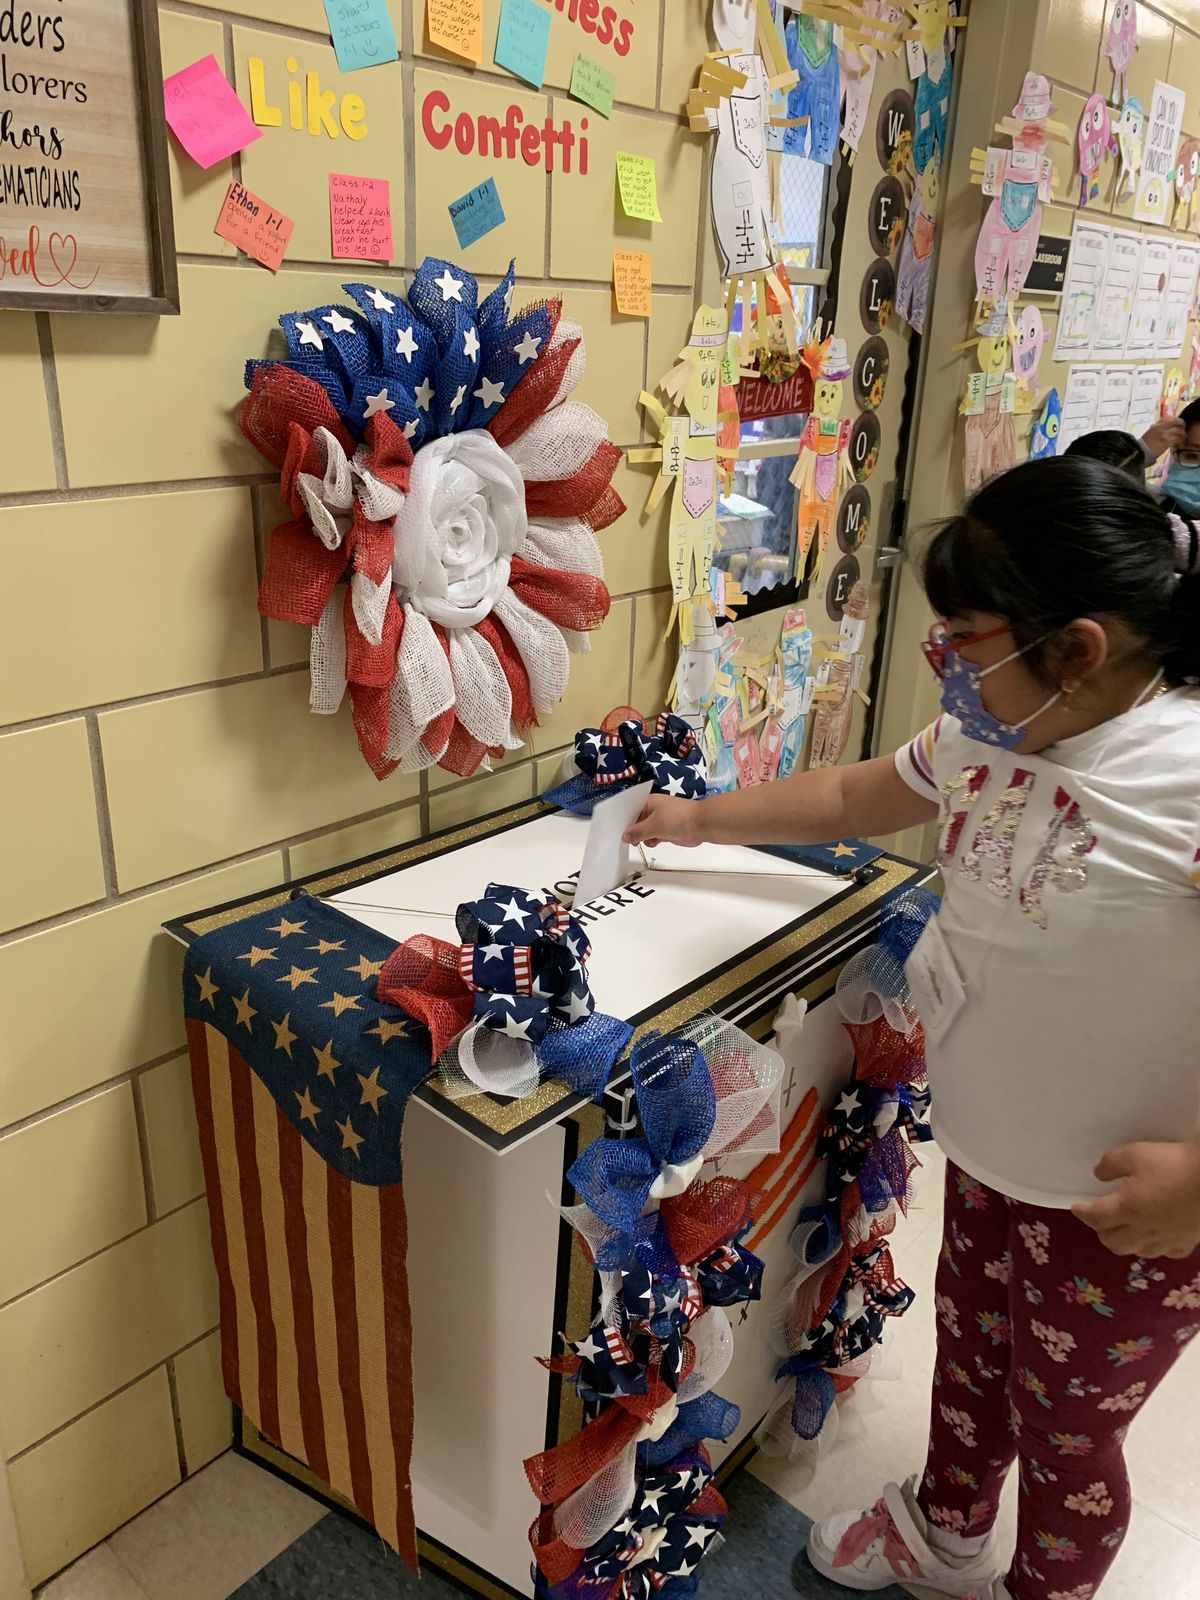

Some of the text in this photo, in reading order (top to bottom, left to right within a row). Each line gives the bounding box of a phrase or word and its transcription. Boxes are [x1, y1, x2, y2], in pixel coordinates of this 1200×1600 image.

[248, 56, 368, 141] Like
[422, 90, 589, 175] Confetti
[229, 182, 259, 217] Ethan
[449, 193, 475, 219] David
[573, 881, 656, 928] HERE
